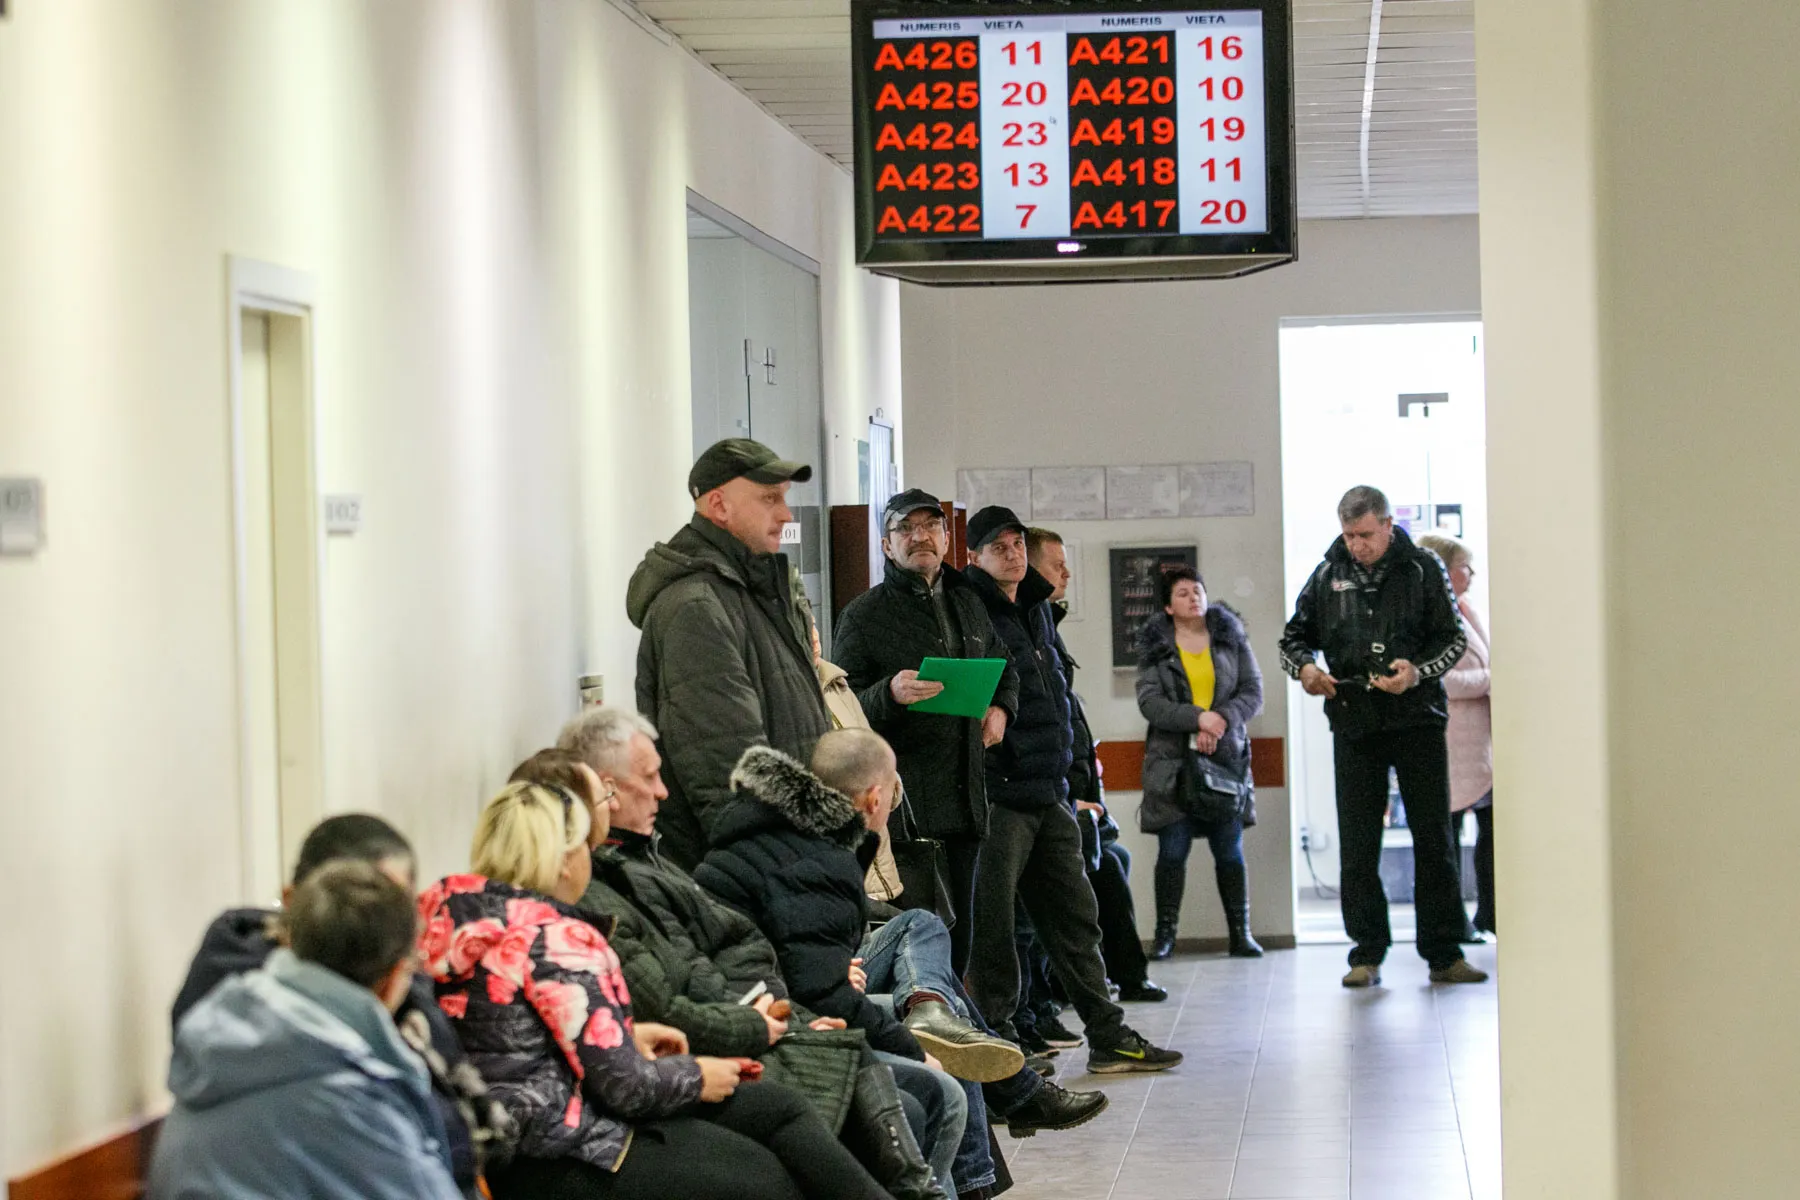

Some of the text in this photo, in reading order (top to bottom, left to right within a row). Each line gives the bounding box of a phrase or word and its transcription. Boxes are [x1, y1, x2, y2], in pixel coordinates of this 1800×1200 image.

[900, 15, 1226, 32] NUMERIS VIETA NUMERIS VIETA
[875, 36, 1243, 71] A426 11 A421 16
[876, 76, 1244, 111] A425 20 A420 10
[876, 116, 1246, 151] A424 23 A419 19
[877, 157, 1242, 191] A423 13 A418 11
[878, 199, 1247, 233] A422 7 A417 20
[326, 502, 361, 521] 102
